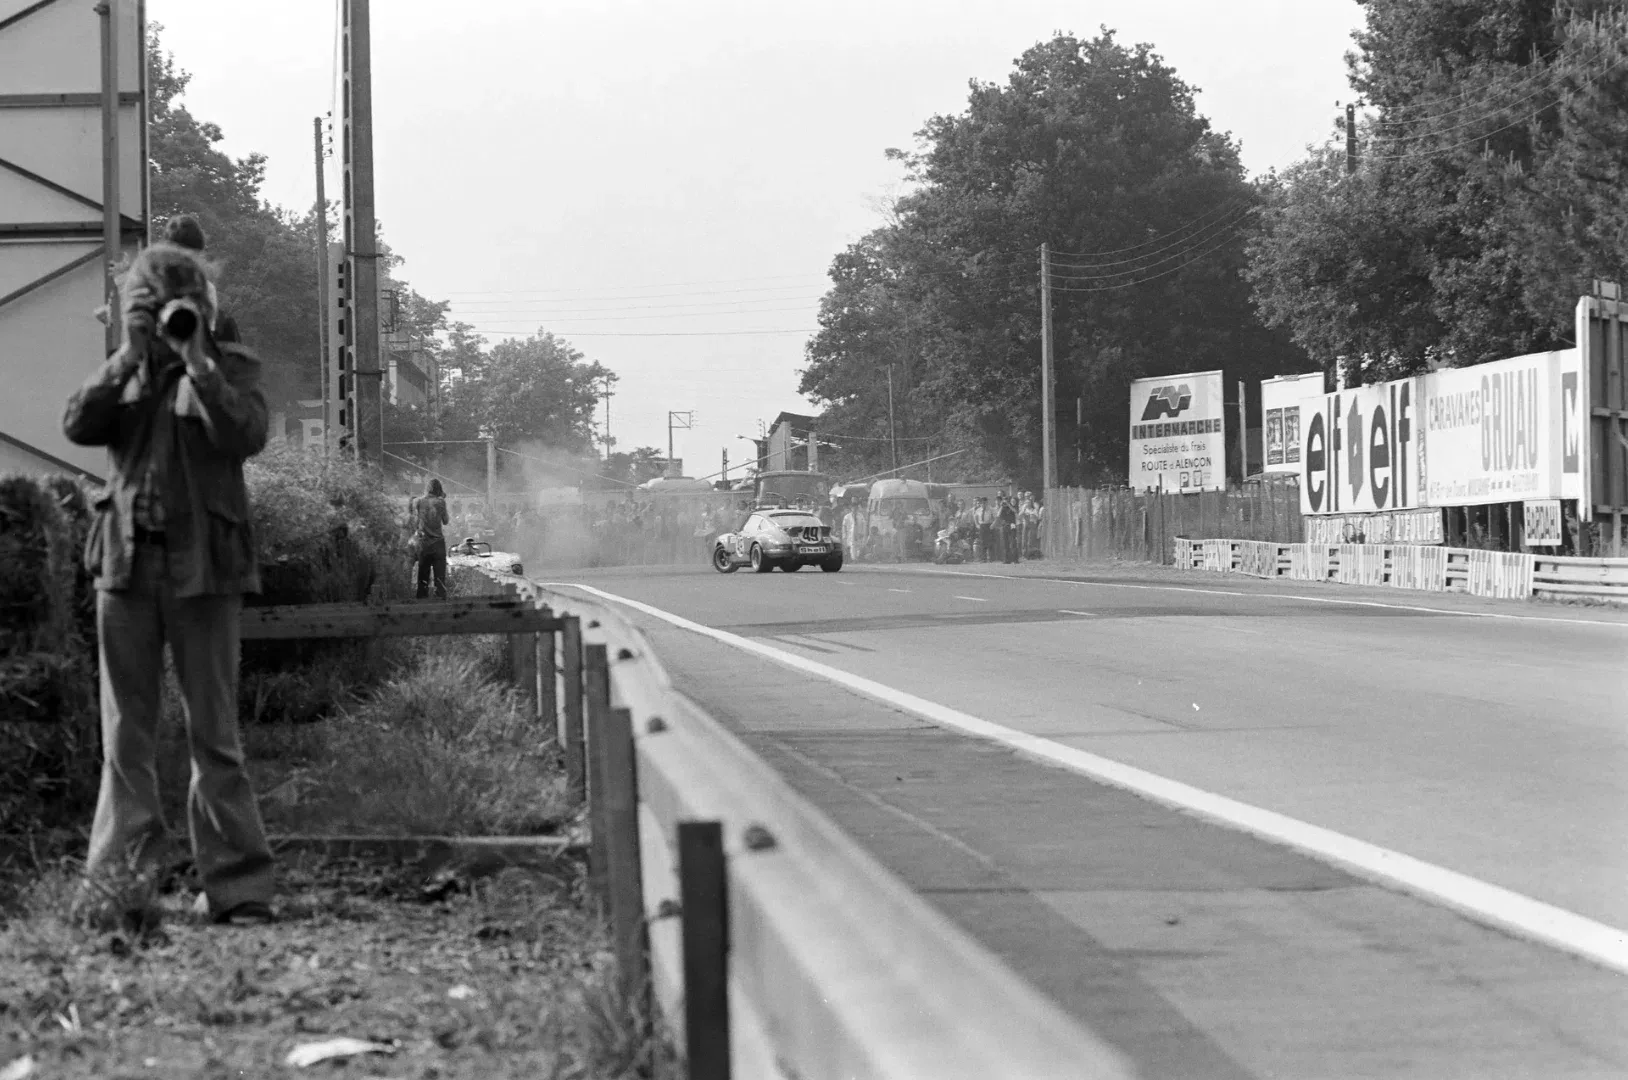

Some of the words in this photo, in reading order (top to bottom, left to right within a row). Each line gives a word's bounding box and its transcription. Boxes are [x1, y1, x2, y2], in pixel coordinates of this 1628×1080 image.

[1132, 418, 1221, 440] INTERMARCHE
[1429, 390, 1480, 431] CARAVANES
[1481, 368, 1538, 472] GRUAU
[1143, 443, 1179, 455] Spécialiste
[1181, 444, 1189, 452] du
[1191, 441, 1206, 451] frais
[1306, 394, 1341, 512] elf
[1369, 381, 1410, 509] elf
[1141, 460, 1168, 471] ROUTE
[1169, 457, 1212, 470] dALENÇON
[803, 526, 819, 541] 49
